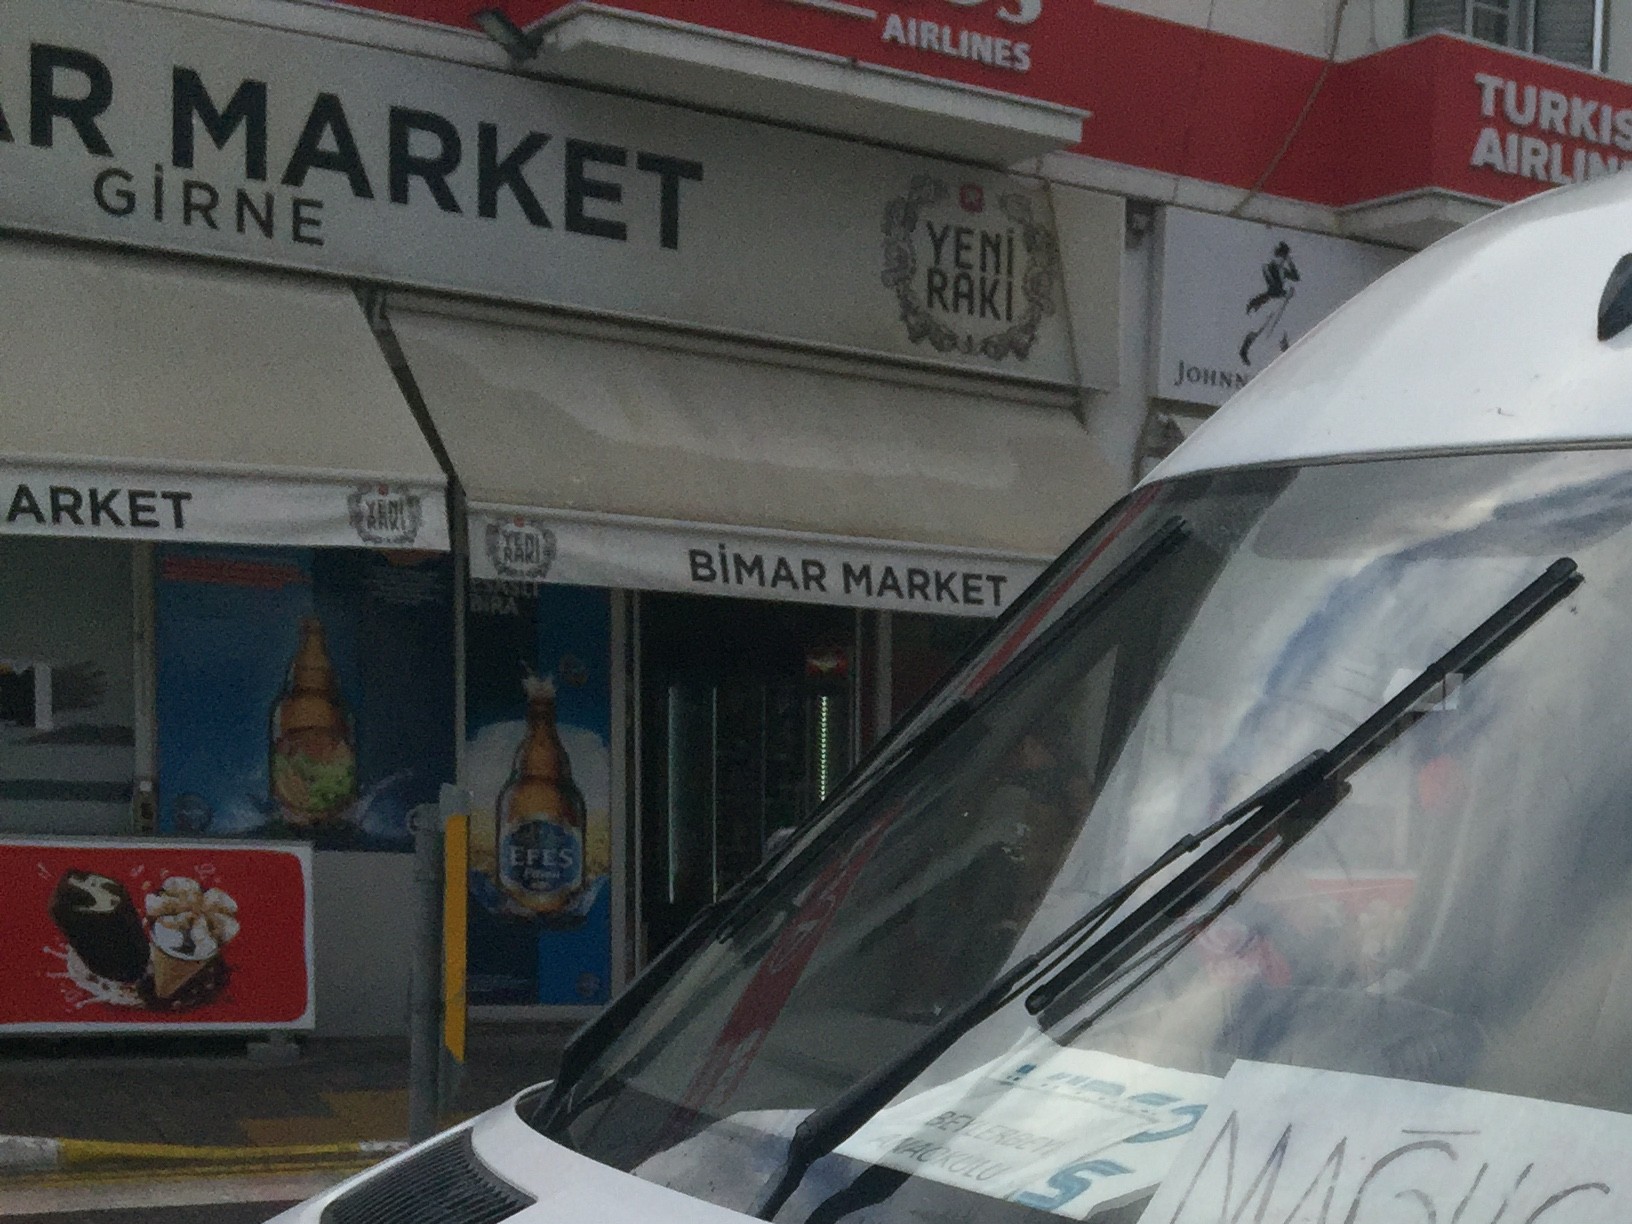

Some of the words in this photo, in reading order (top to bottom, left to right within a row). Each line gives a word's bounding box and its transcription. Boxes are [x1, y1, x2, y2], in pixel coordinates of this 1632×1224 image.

[881, 13, 1032, 71] AIRLINES
[172, 64, 704, 250] MARKET
[94, 162, 325, 246] GİRNE
[927, 220, 1015, 276] YENİ
[927, 267, 1013, 322] RAKI
[6, 483, 193, 529] ARKET
[688, 543, 827, 593] BİMAR
[842, 561, 1008, 607] MARKET
[510, 845, 574, 868] EFES
